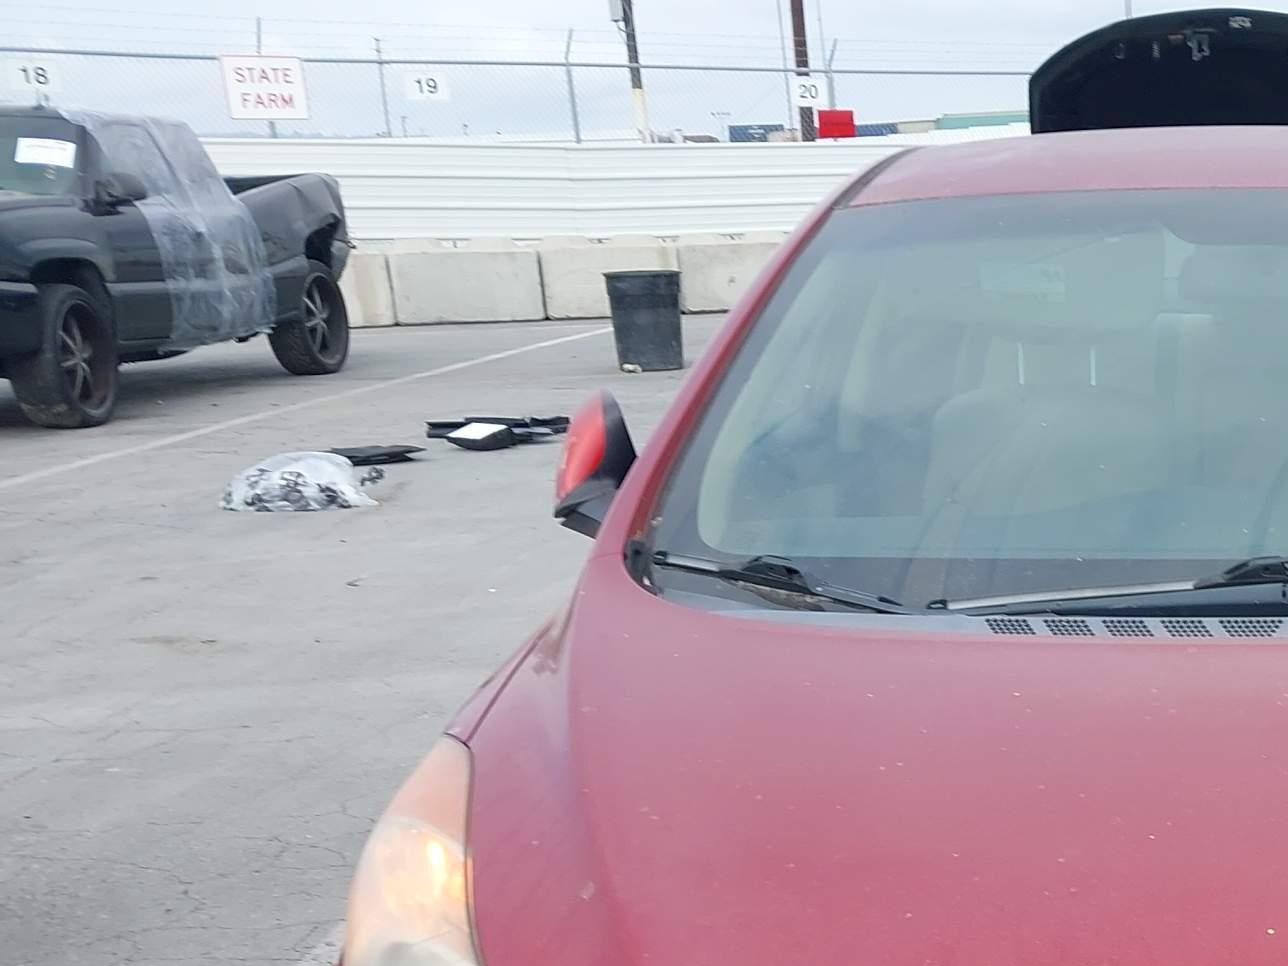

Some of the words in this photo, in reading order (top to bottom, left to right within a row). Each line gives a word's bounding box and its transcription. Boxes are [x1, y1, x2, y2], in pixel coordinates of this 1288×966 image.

[18, 65, 50, 86] 18
[232, 66, 295, 85] STATE
[413, 77, 439, 95] 19
[798, 83, 819, 99] 20
[239, 92, 297, 110] FARM
